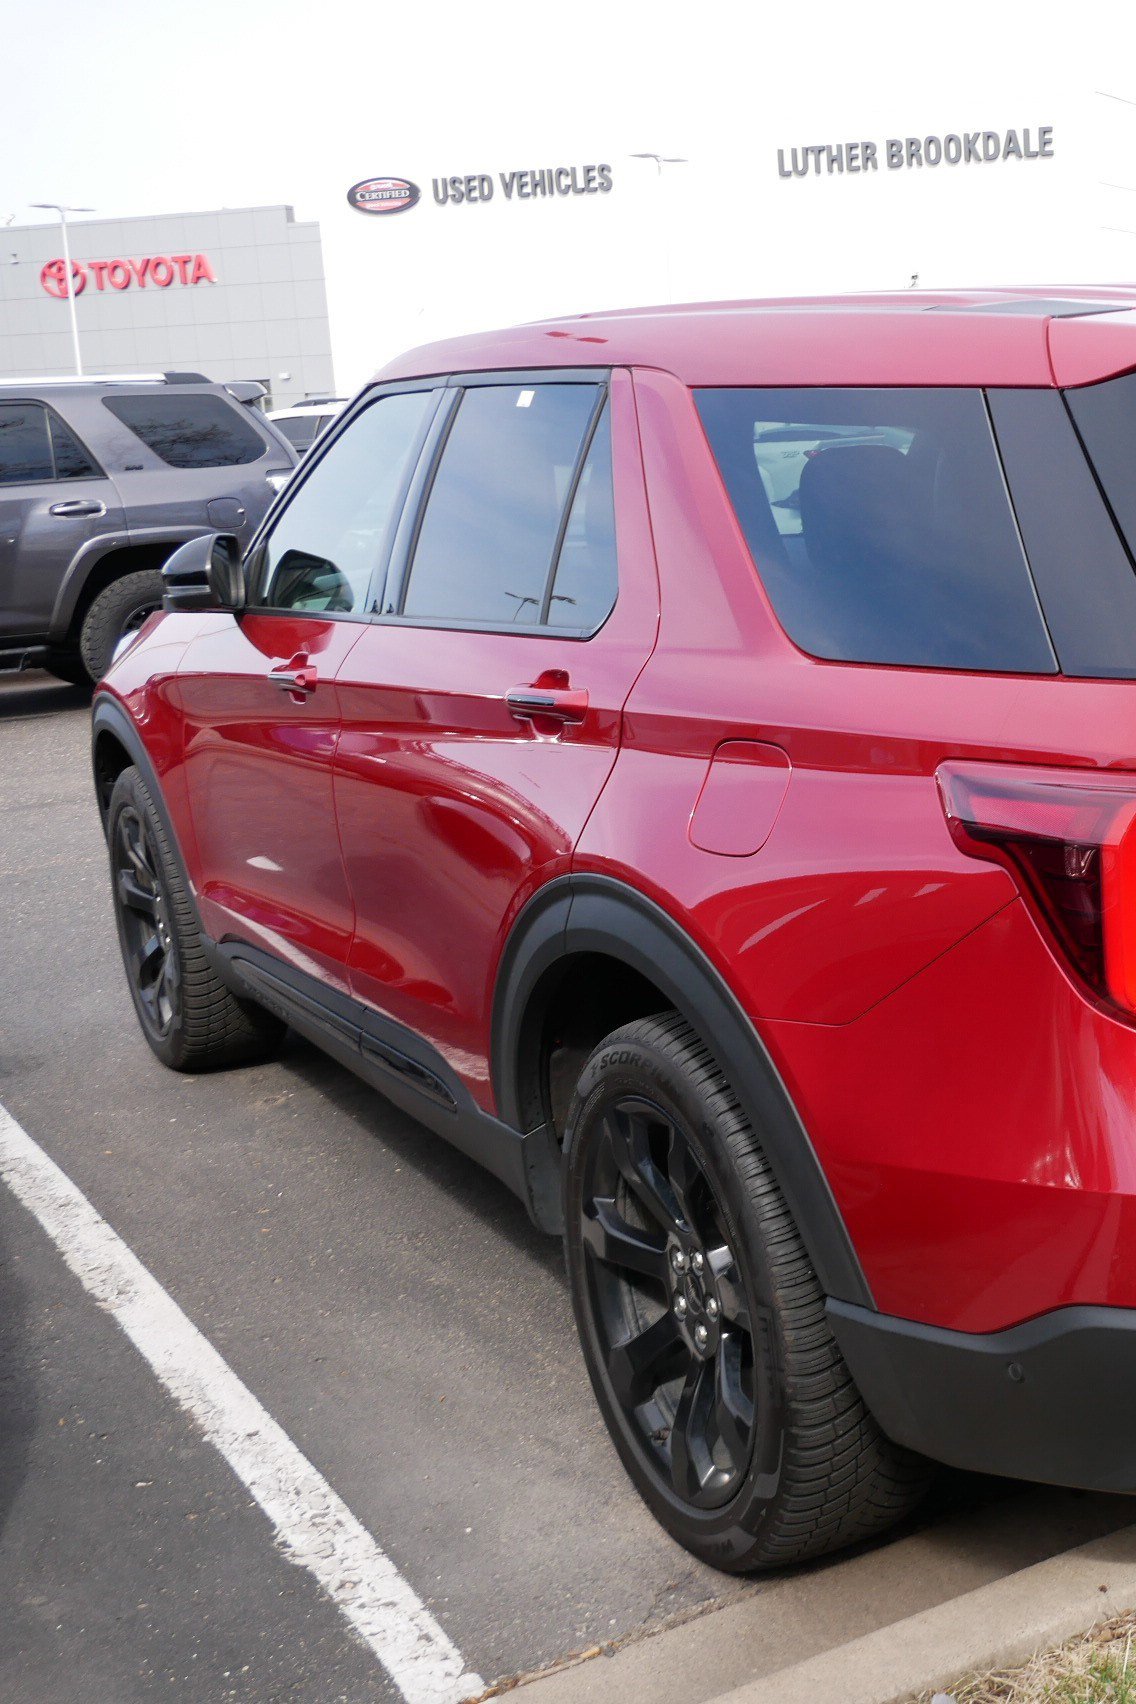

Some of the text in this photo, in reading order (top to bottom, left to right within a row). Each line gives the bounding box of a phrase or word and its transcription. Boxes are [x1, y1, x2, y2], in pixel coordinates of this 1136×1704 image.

[777, 126, 1054, 177] LUTHER BROOKDALE
[432, 163, 613, 204] USED VEHICLES
[88, 254, 217, 291] TOYOTA
